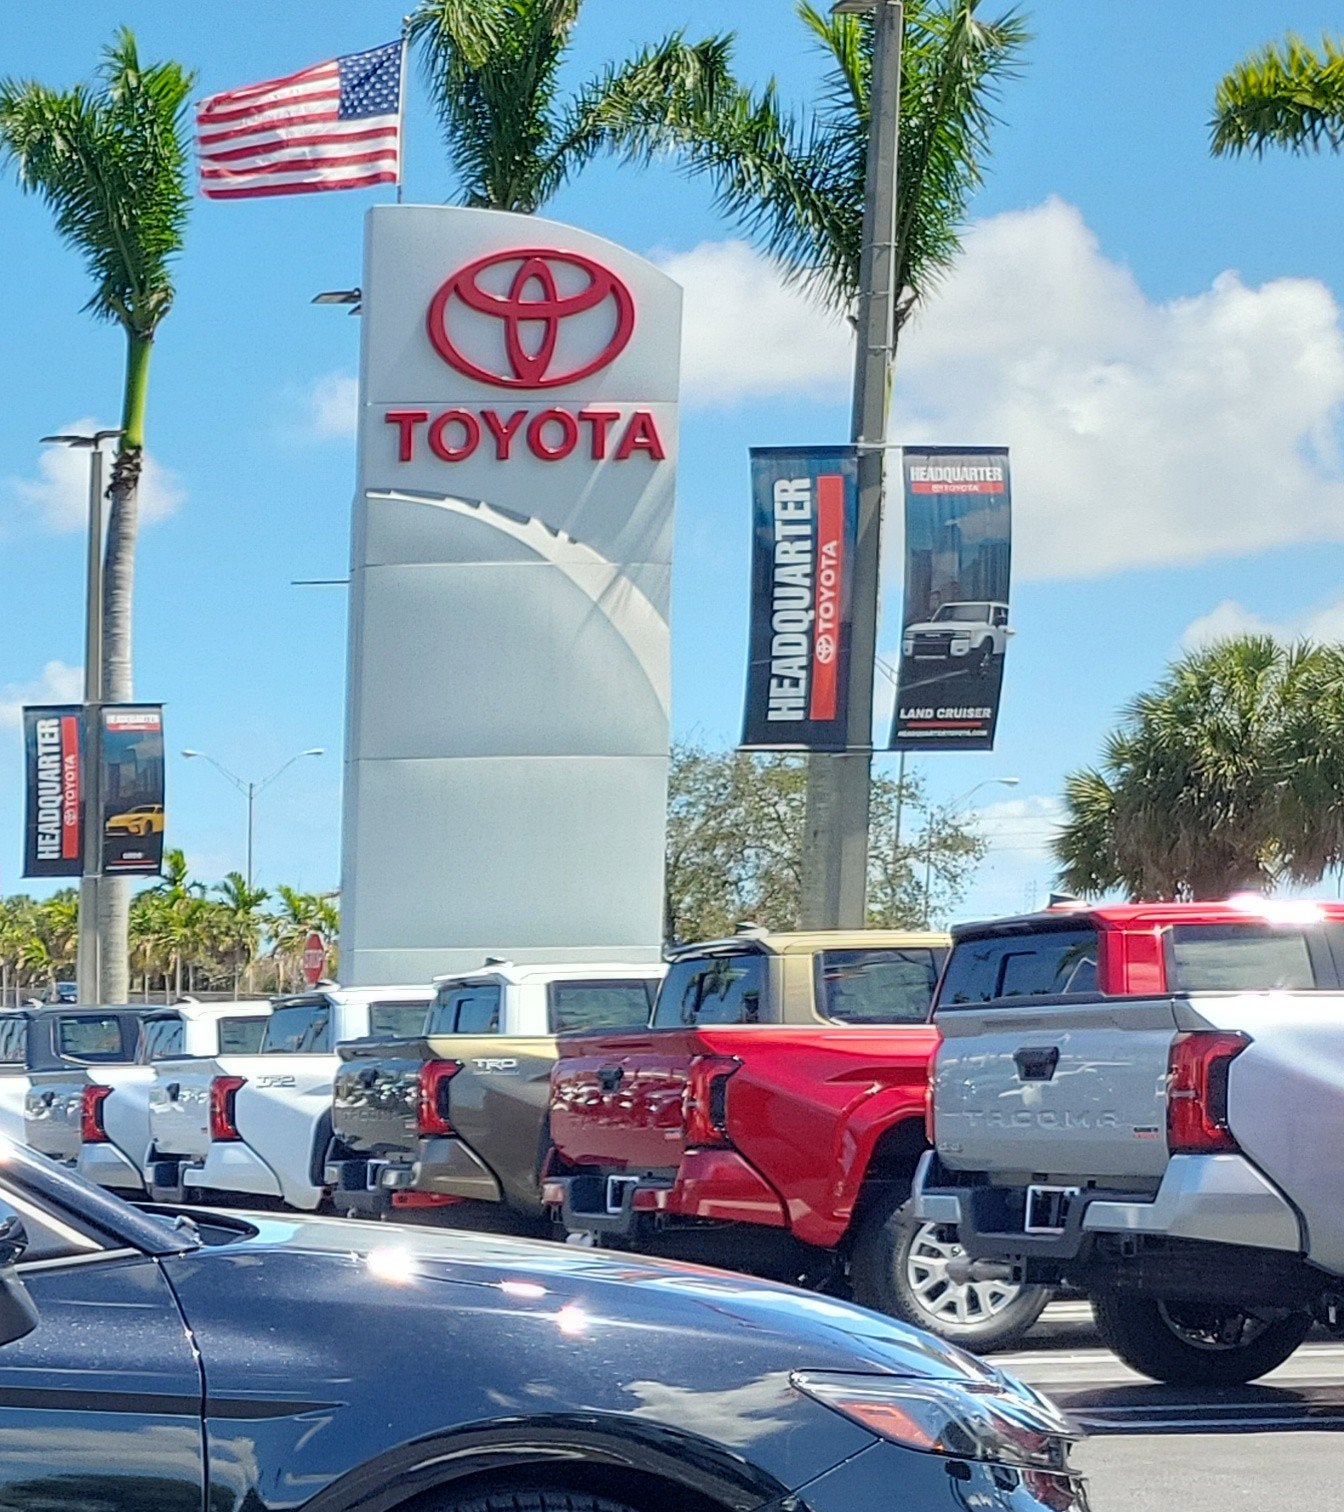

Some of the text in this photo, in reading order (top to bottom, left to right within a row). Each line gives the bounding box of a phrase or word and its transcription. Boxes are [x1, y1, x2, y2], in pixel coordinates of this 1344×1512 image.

[384, 406, 666, 463] TOYOTA
[910, 466, 1003, 483] HEADQUARTER
[767, 477, 815, 722] HEADQUARTER
[818, 540, 839, 634] TOYOTA
[900, 708, 992, 719] LAND CRUISER
[36, 717, 63, 860] HEADQUARTER
[64, 754, 78, 809] TOYOTA
[471, 1058, 518, 1071] TRD
[962, 1109, 1119, 1131] TACOMA
